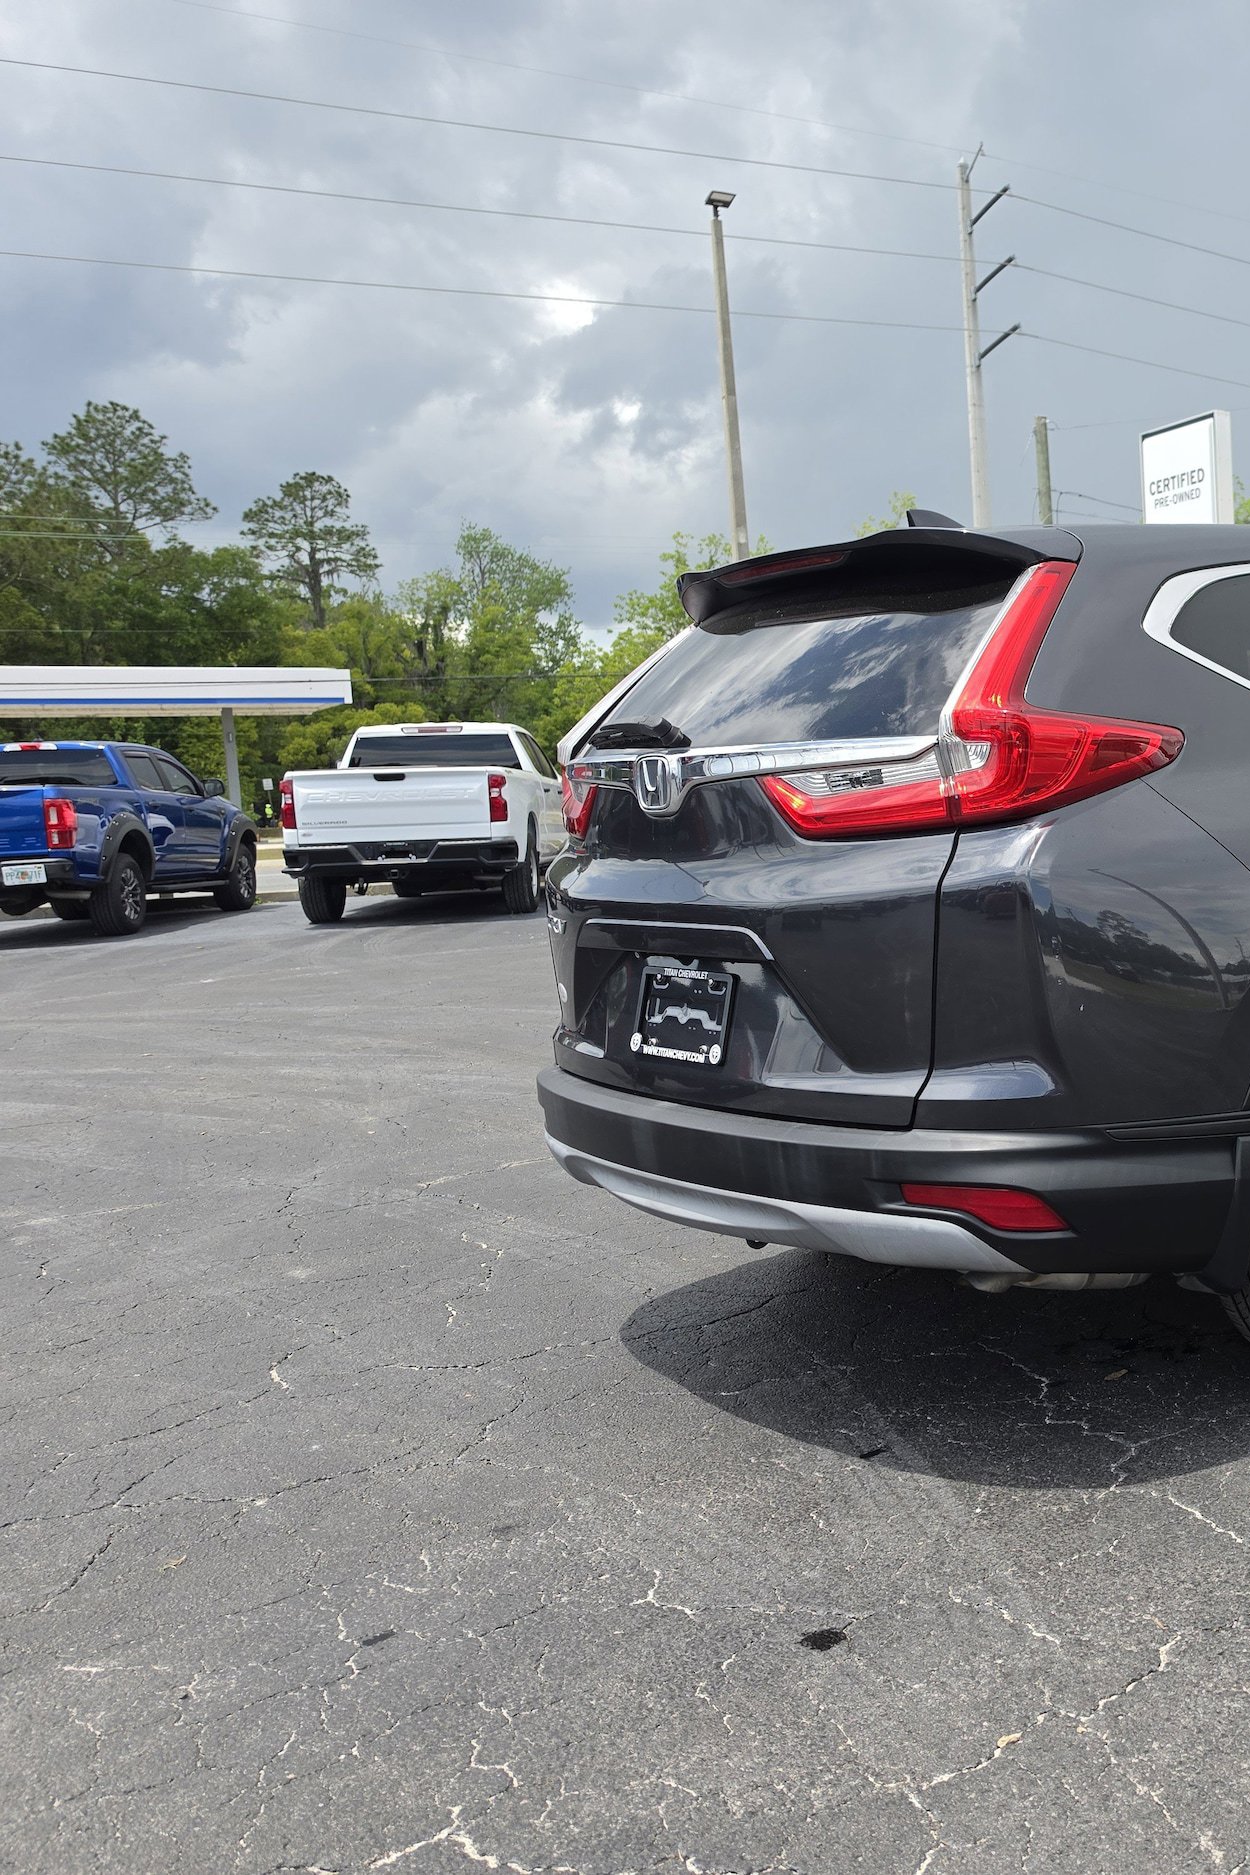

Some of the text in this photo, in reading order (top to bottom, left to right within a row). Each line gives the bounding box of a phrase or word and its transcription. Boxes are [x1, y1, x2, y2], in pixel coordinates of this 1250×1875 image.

[1149, 468, 1205, 496] CERTIFIED
[1154, 487, 1201, 509] PRE-OWNED
[307, 787, 475, 803] CHEVROLET
[664, 968, 708, 980] TITAN CHEVROLET
